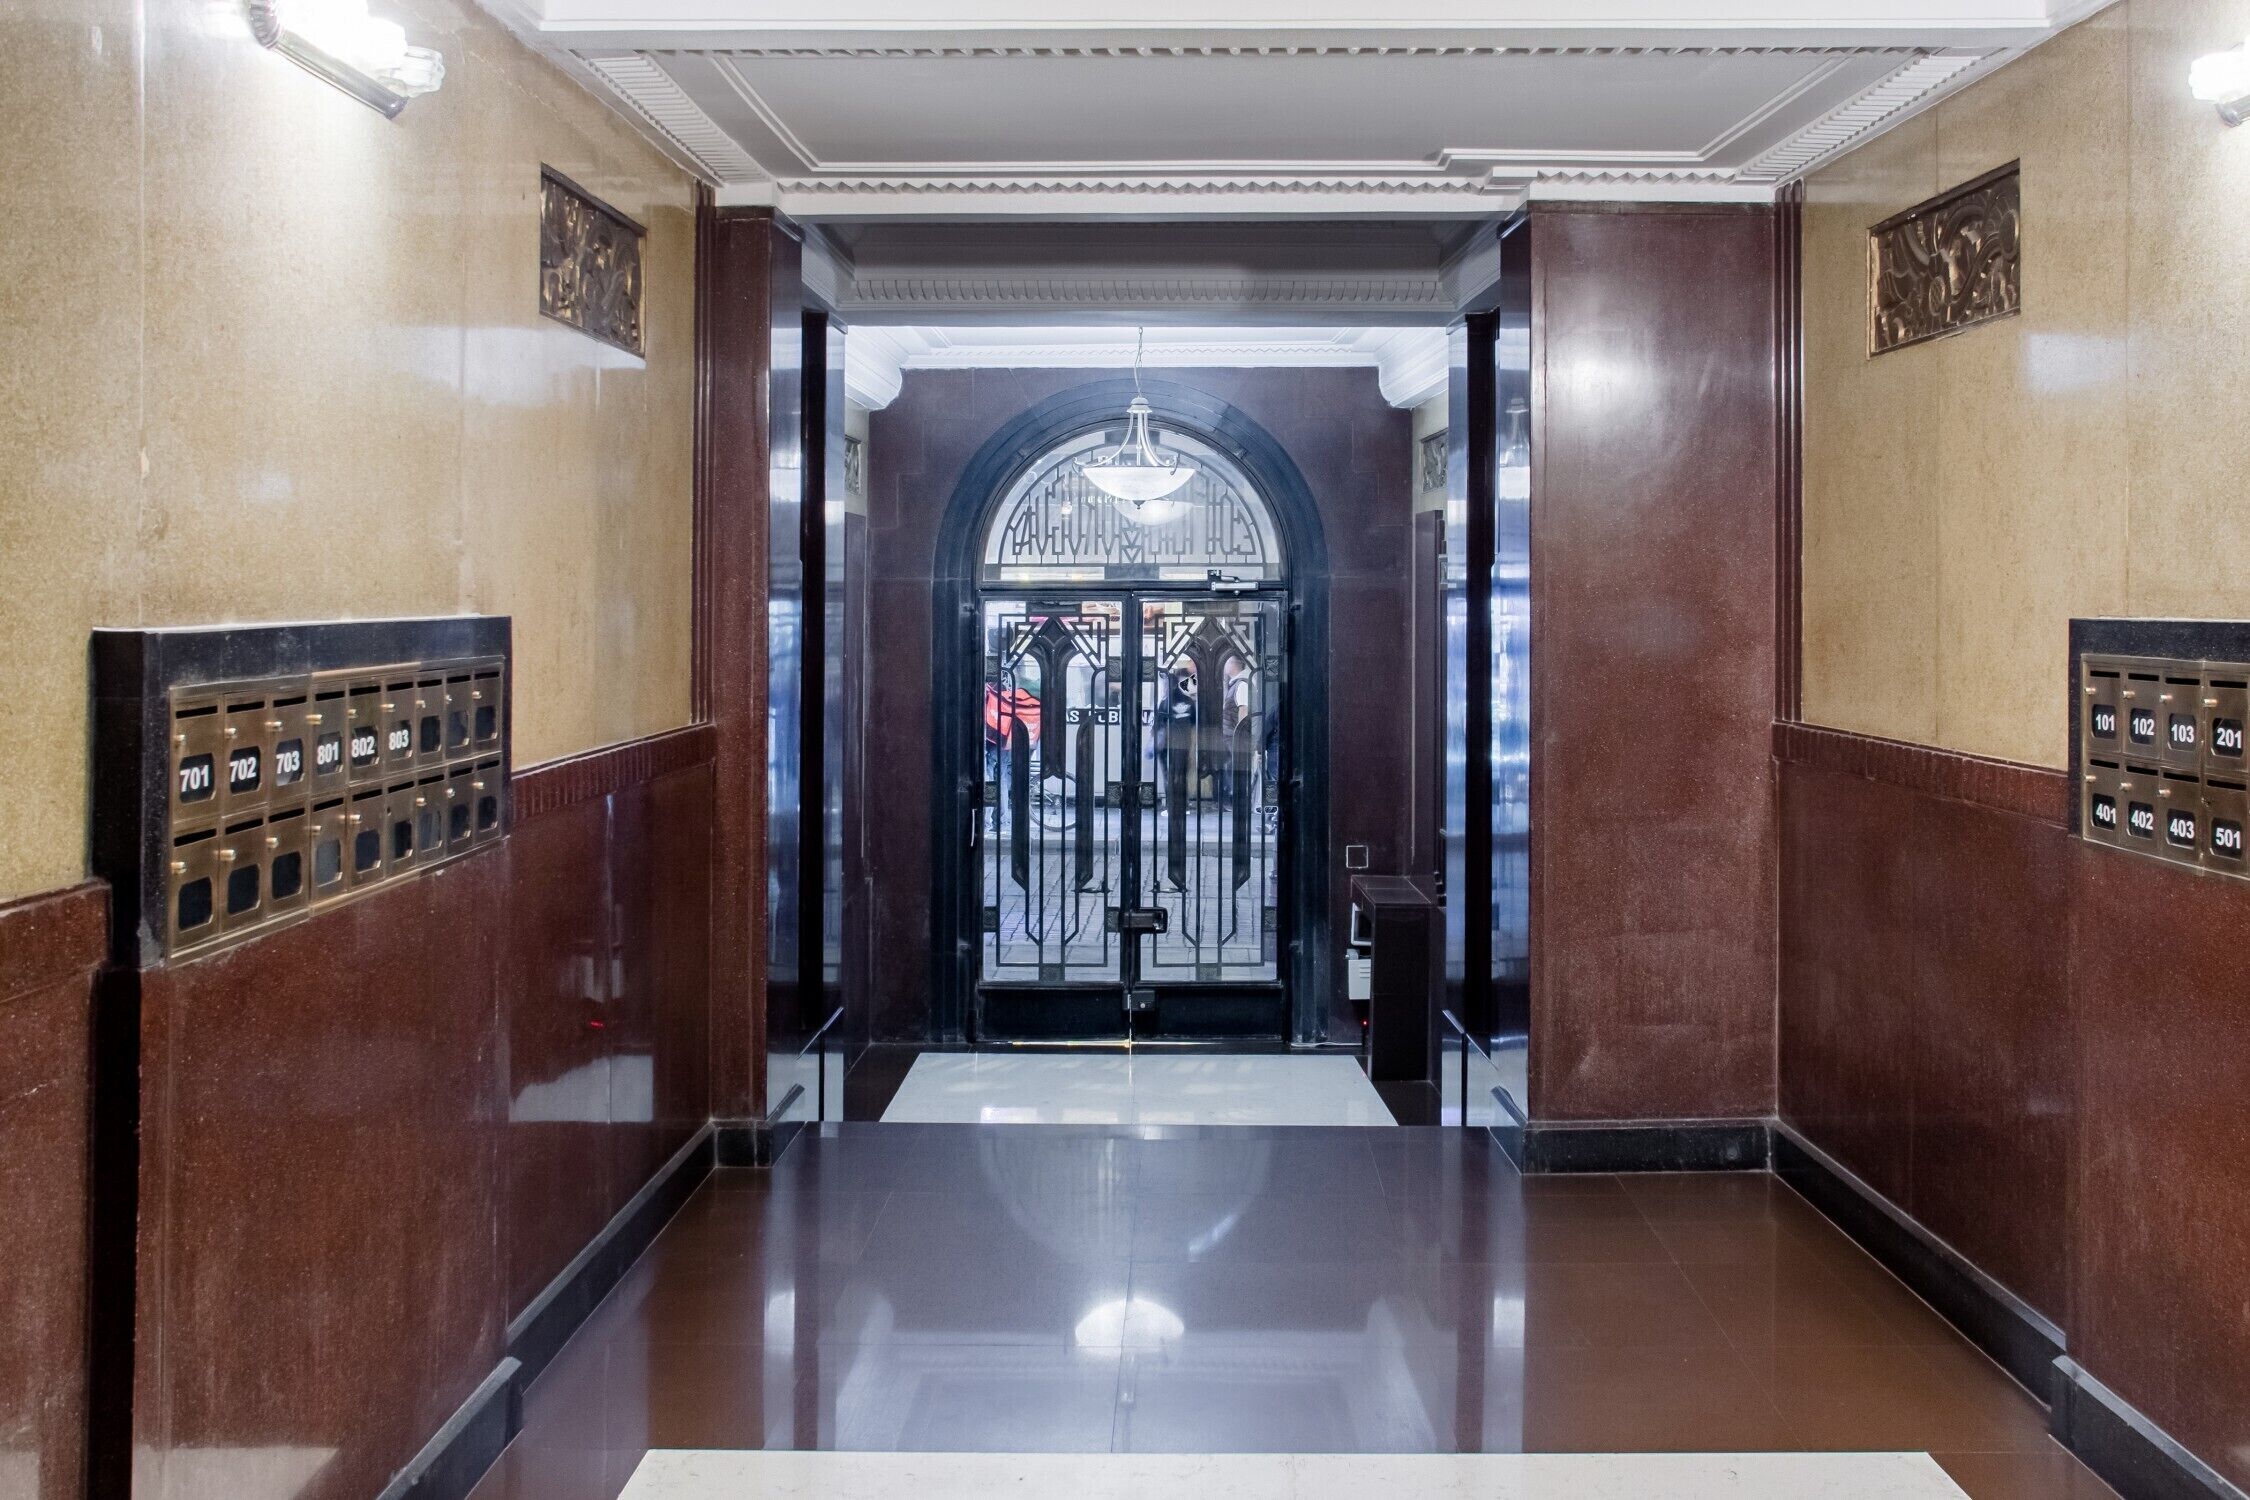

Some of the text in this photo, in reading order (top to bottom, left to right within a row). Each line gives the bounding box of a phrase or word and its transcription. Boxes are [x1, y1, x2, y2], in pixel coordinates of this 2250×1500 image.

[2095, 714, 2115, 731] 101
[2132, 718, 2154, 736] 102
[388, 729, 409, 751] 803
[2171, 724, 2195, 743] 103
[2216, 727, 2242, 748] 201
[317, 741, 339, 765] 801
[351, 736, 375, 758] 802
[229, 757, 257, 782] 702
[276, 750, 300, 774] 703
[180, 765, 210, 792] 701
[2096, 803, 2116, 824] 401
[2131, 809, 2153, 830] 402
[2170, 818, 2195, 838] 403
[2215, 827, 2241, 849] 501
